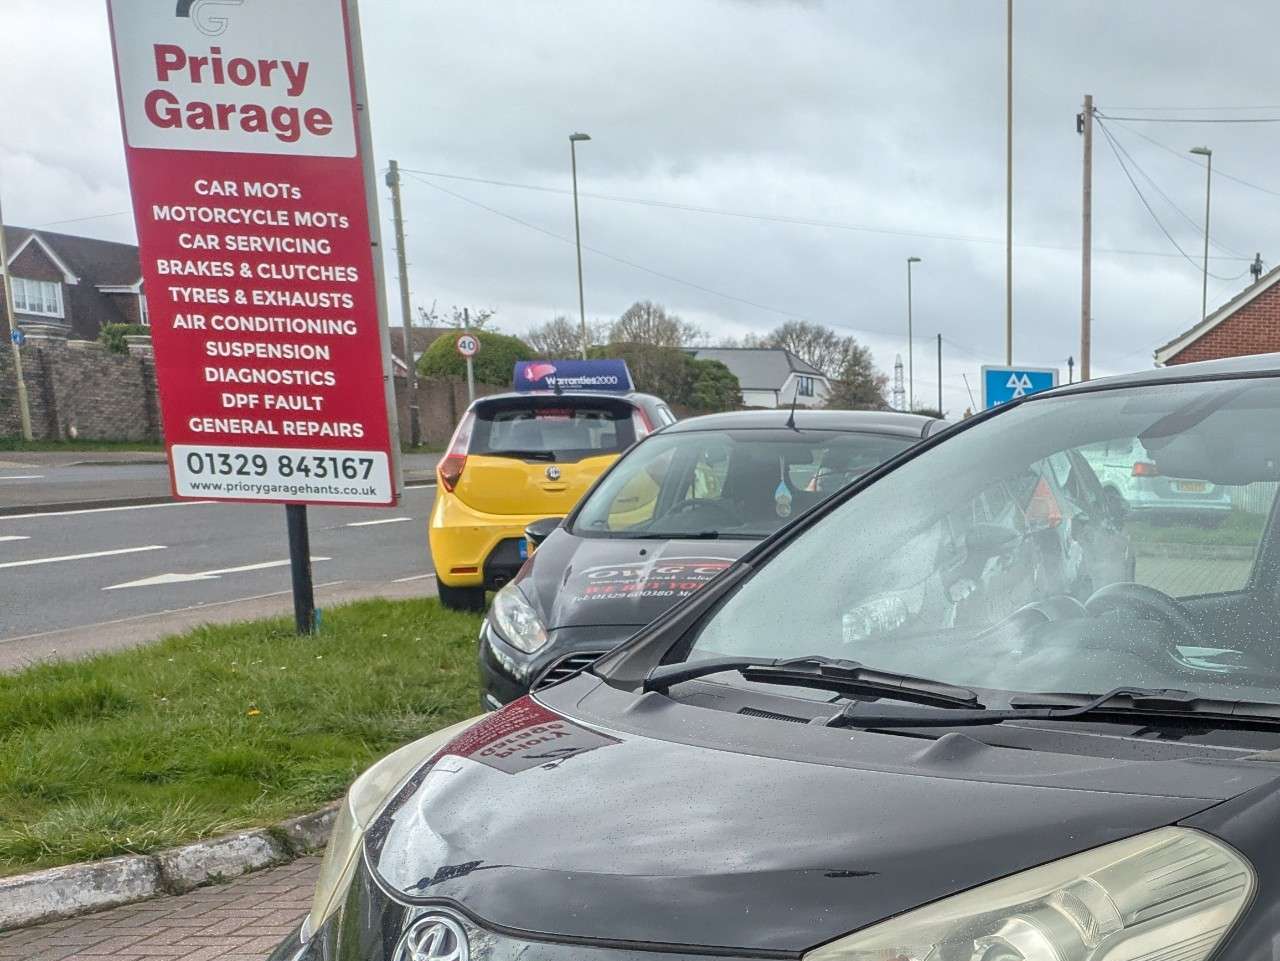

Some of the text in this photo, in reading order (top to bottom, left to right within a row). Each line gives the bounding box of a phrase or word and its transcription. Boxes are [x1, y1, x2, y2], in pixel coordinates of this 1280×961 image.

[153, 44, 309, 97] Priory
[144, 89, 332, 143] Garage
[195, 180, 301, 199] CAR MOTs
[152, 206, 349, 228] MOTORCYCLE MOTs
[179, 234, 332, 254] CAR SERVICING
[157, 260, 358, 282] BRAKES & CLUTCHES
[168, 287, 354, 308] TYRES & EXHAUSTS
[173, 314, 357, 335] AIR CONDITIONING
[206, 342, 330, 360] SUSPENSION
[460, 340, 476, 351] 40
[205, 368, 336, 386] DIAGNOSTICS
[222, 393, 323, 411] DPF FAULT
[189, 417, 364, 437] GENERAL REPAIRS
[186, 451, 374, 480] 01329 843167
[190, 481, 377, 496] www.priorygaragehants.co.uk
